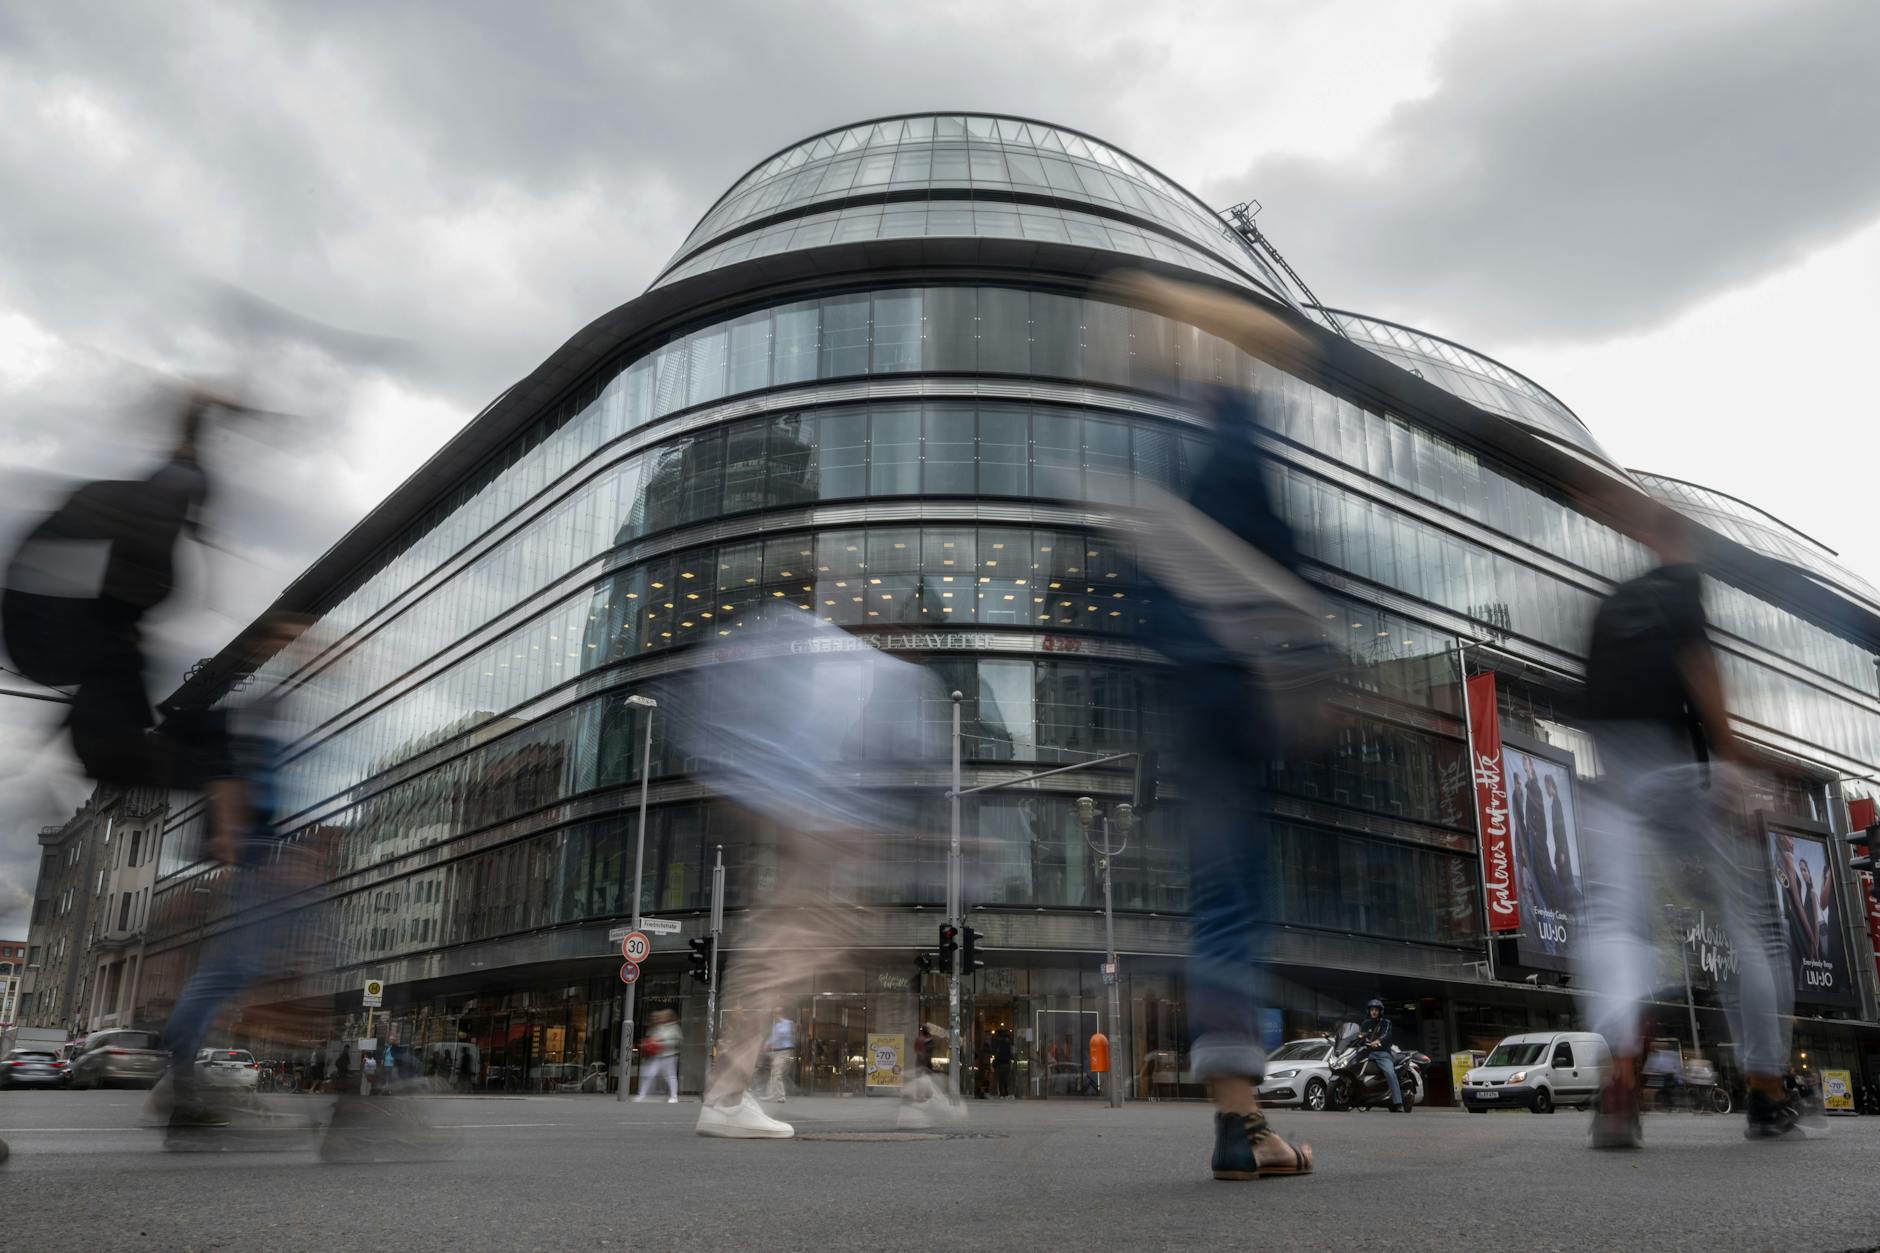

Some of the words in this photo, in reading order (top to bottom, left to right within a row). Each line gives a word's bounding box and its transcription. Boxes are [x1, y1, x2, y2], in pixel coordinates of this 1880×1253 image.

[887, 633, 994, 650] LAFAYETTE
[1486, 841, 1518, 914] Galeries
[628, 940, 644, 954] 30
[1701, 939, 1742, 982] Lafayett
